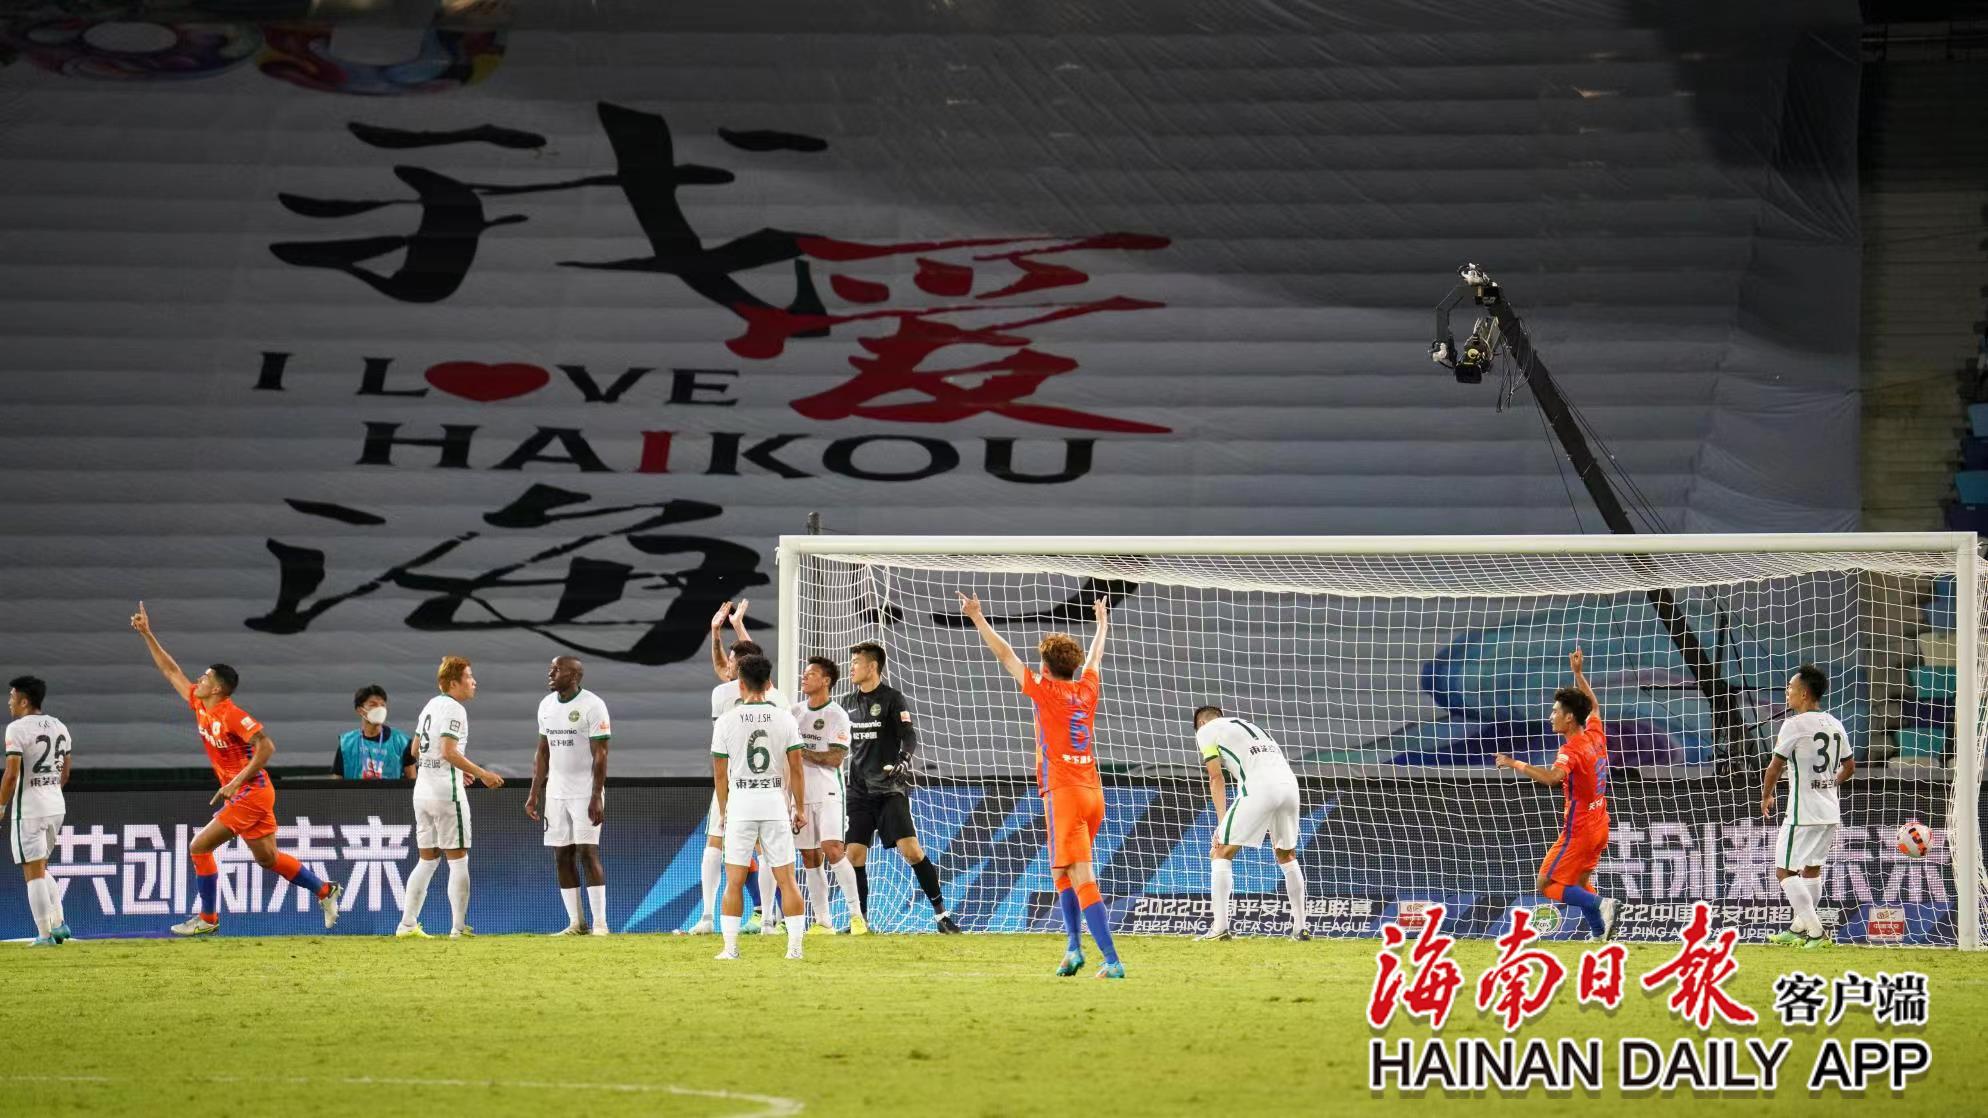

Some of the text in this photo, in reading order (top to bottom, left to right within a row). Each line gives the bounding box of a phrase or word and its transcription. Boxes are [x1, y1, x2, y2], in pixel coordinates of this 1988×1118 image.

[252, 350, 291, 391] I
[355, 421, 1096, 484] HAIKOU
[740, 713, 754, 723] YAO
[1070, 710, 1090, 751] 6
[32, 734, 67, 774] 26
[747, 729, 771, 774] 6
[1812, 731, 1842, 774] 31
[1173, 920, 1208, 932] PING
[1233, 920, 1260, 932] CFA
[1264, 920, 1311, 932] SUPR
[1314, 920, 1371, 932] LEAGUE
[1631, 926, 1667, 938] PING
[1739, 928, 1776, 939] UPER
